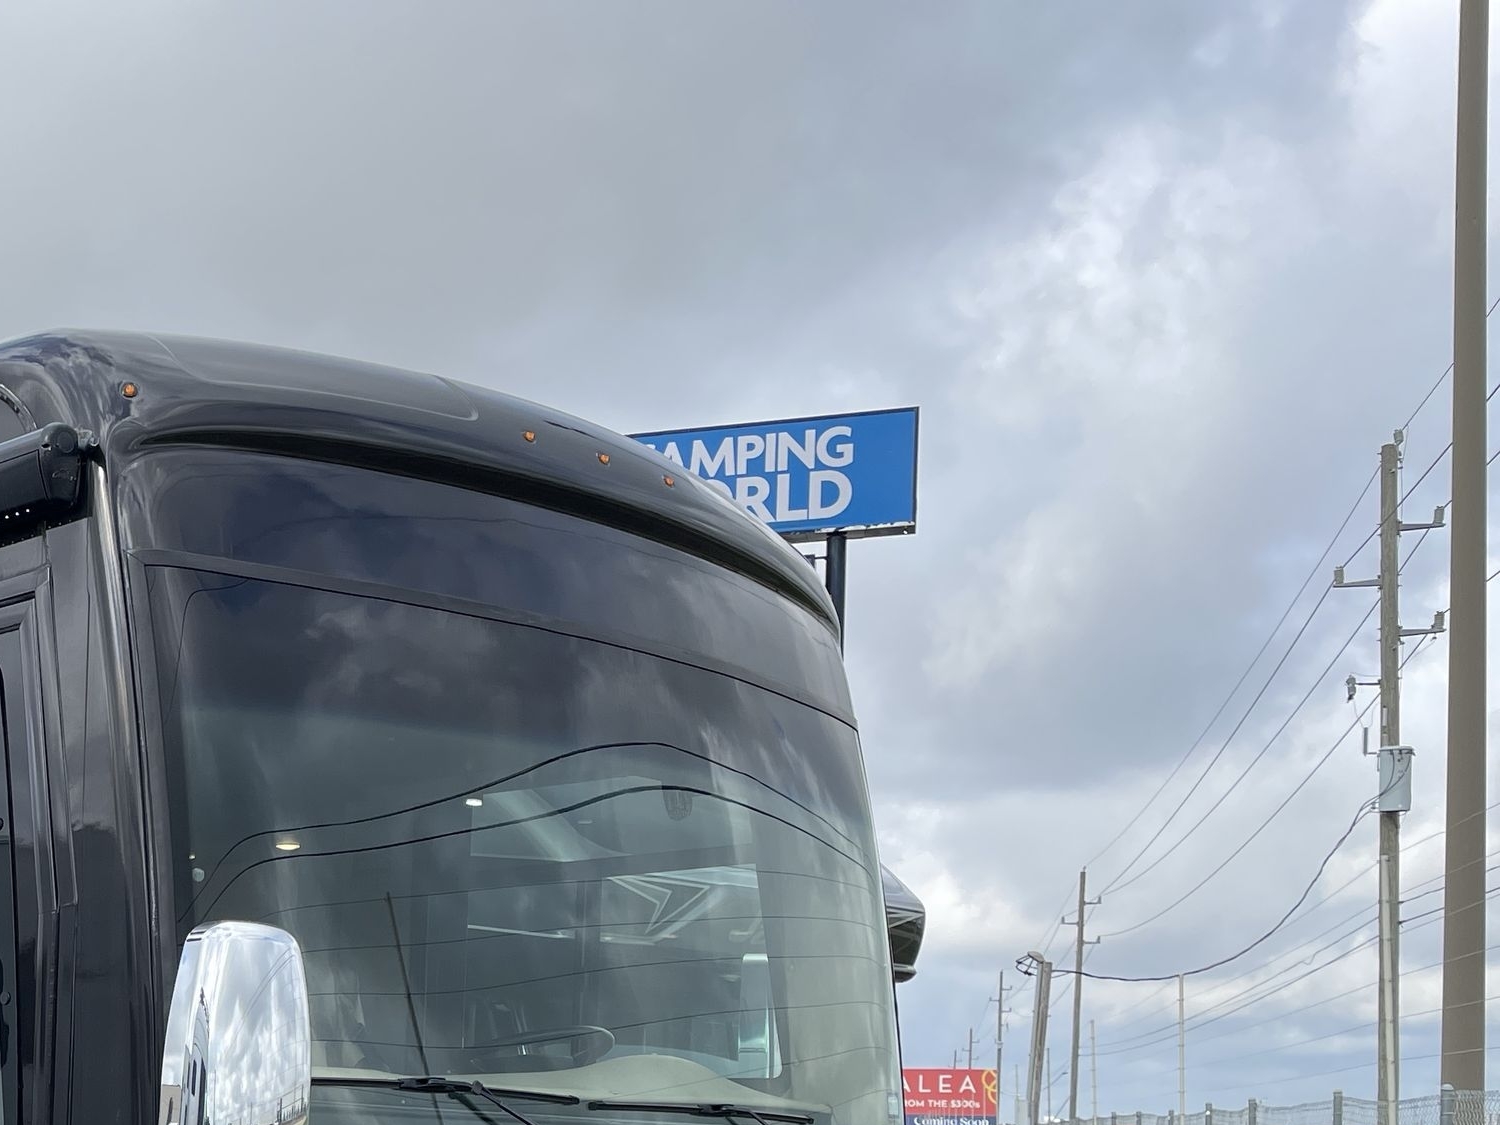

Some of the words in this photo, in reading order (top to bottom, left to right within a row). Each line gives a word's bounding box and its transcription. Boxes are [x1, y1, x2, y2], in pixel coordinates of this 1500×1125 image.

[645, 425, 854, 478] AMPING
[706, 470, 853, 522] RLD
[928, 1099, 948, 1108] THE
